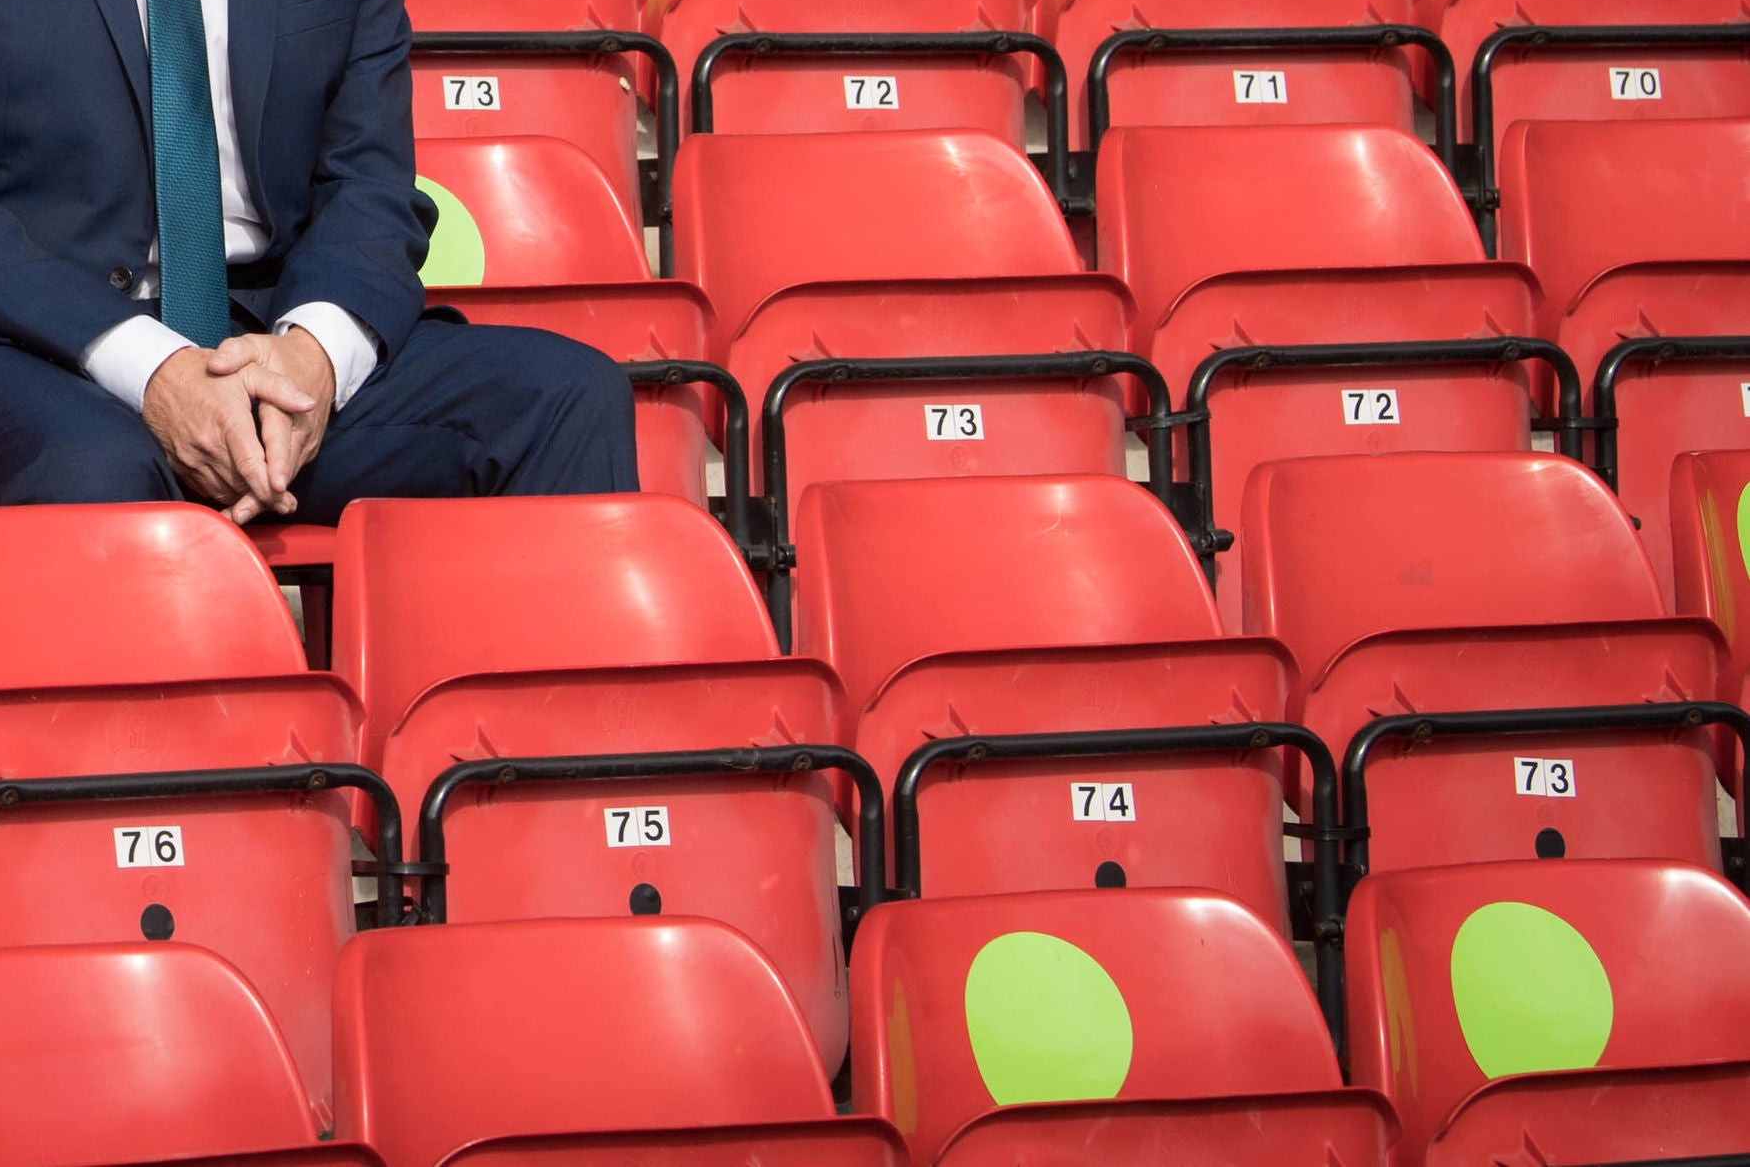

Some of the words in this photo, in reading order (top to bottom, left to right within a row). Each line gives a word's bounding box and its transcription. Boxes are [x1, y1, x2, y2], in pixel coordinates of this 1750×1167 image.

[450, 80, 494, 107] 73
[850, 79, 893, 105] 72
[1240, 74, 1279, 99] 71
[1615, 71, 1657, 96] 70
[1348, 392, 1394, 420] 72
[931, 408, 977, 436] 73
[1521, 761, 1569, 794] 73
[1078, 786, 1129, 817] 74
[611, 810, 664, 843] 75
[122, 830, 176, 863] 76
